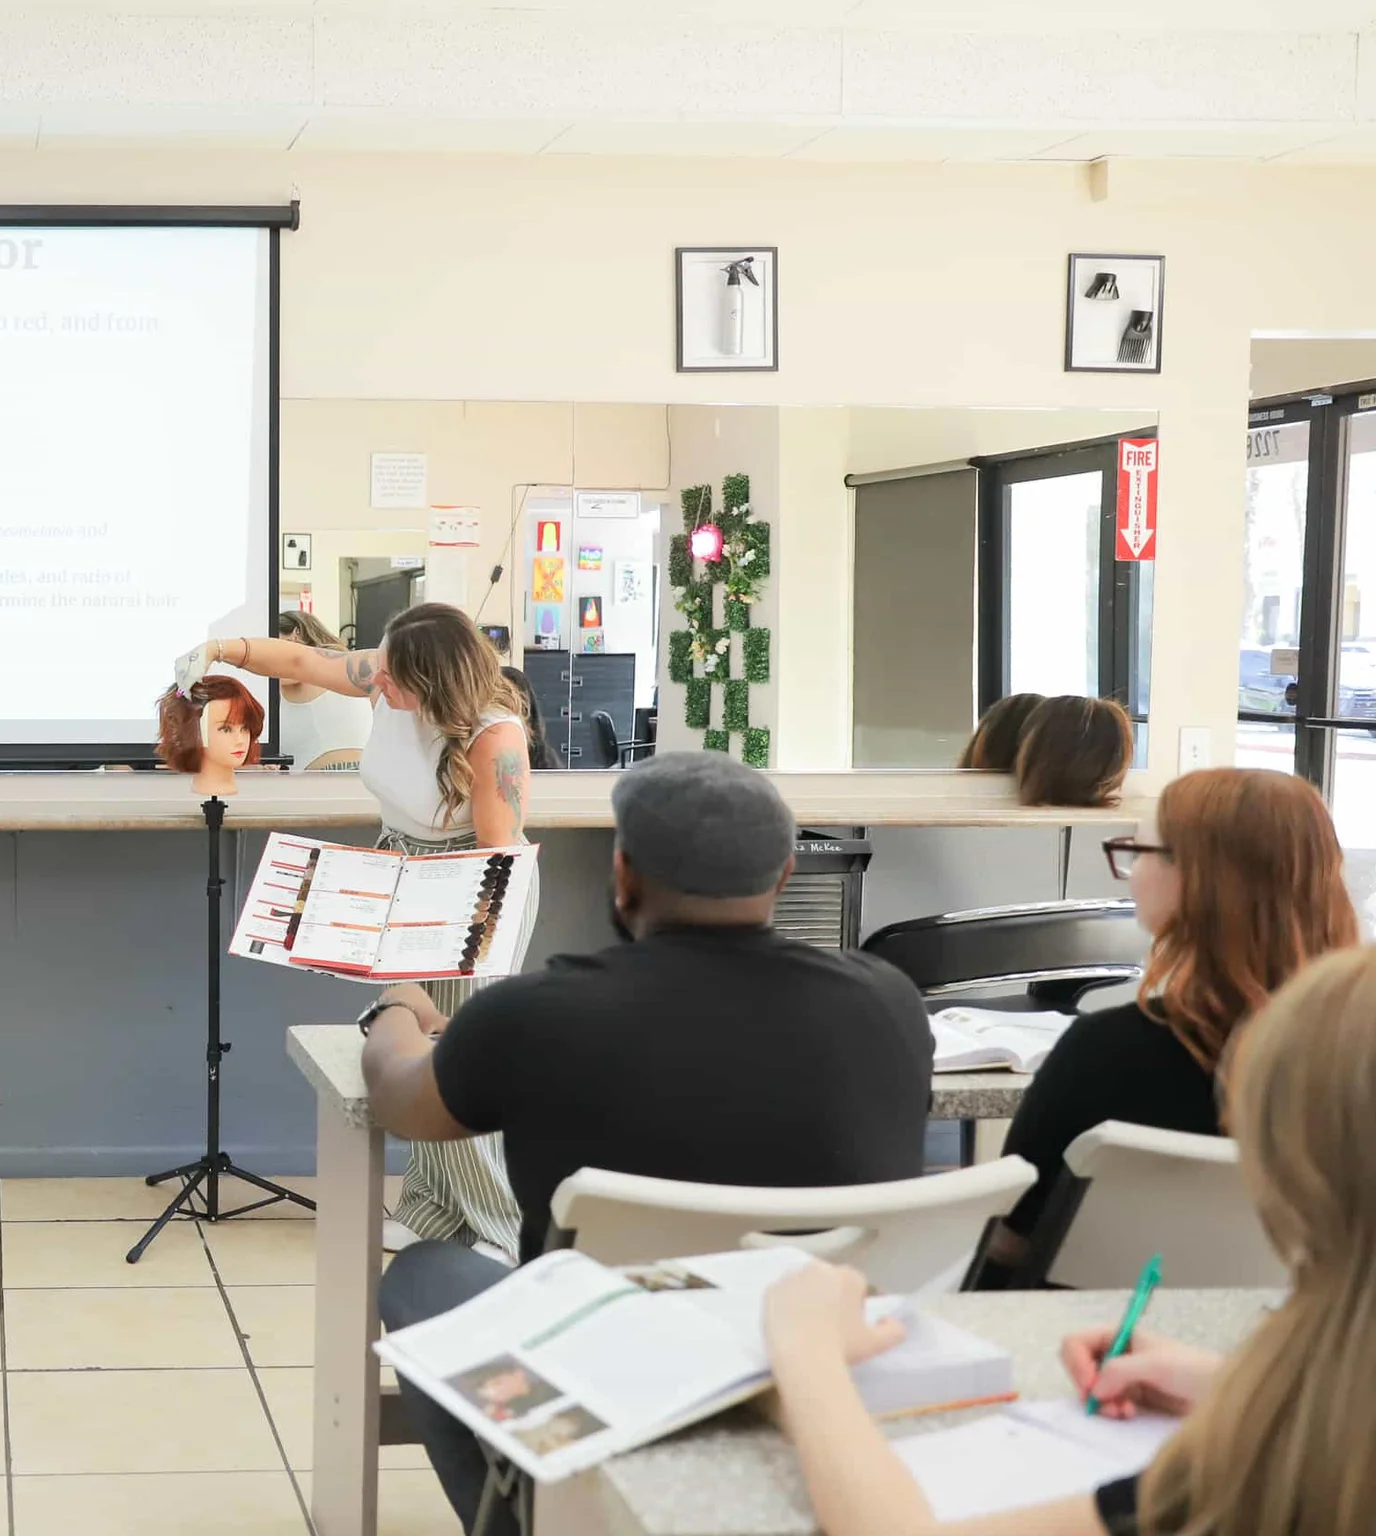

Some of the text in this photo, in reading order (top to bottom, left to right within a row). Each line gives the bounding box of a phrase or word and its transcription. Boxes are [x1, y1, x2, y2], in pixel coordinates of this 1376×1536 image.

[14, 312, 54, 334] red,
[61, 312, 100, 331] and
[106, 312, 159, 331] from
[1126, 451, 1152, 466] FIRE
[1133, 470, 1141, 549] EXTINGUISHER
[77, 523, 109, 538] and
[36, 570, 67, 585] and
[115, 570, 132, 585] of
[51, 594, 77, 608] the
[82, 594, 141, 608] natural
[145, 594, 180, 608] hair
